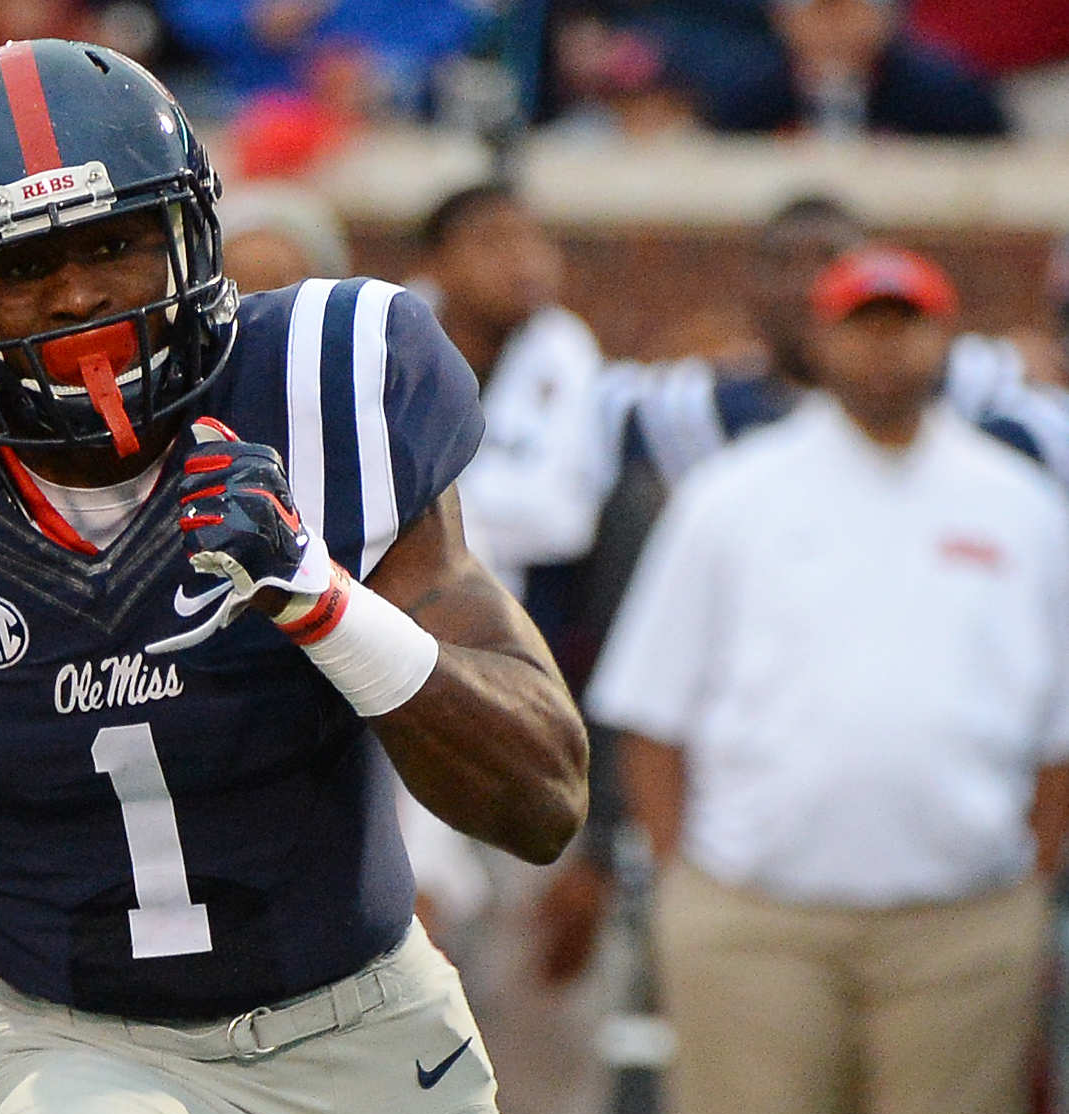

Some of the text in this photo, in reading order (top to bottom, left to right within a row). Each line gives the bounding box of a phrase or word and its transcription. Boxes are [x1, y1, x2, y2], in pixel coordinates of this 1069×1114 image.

[21, 174, 75, 200] REBS
[54, 652, 185, 714] Ole Miss
[90, 721, 214, 960] 1
